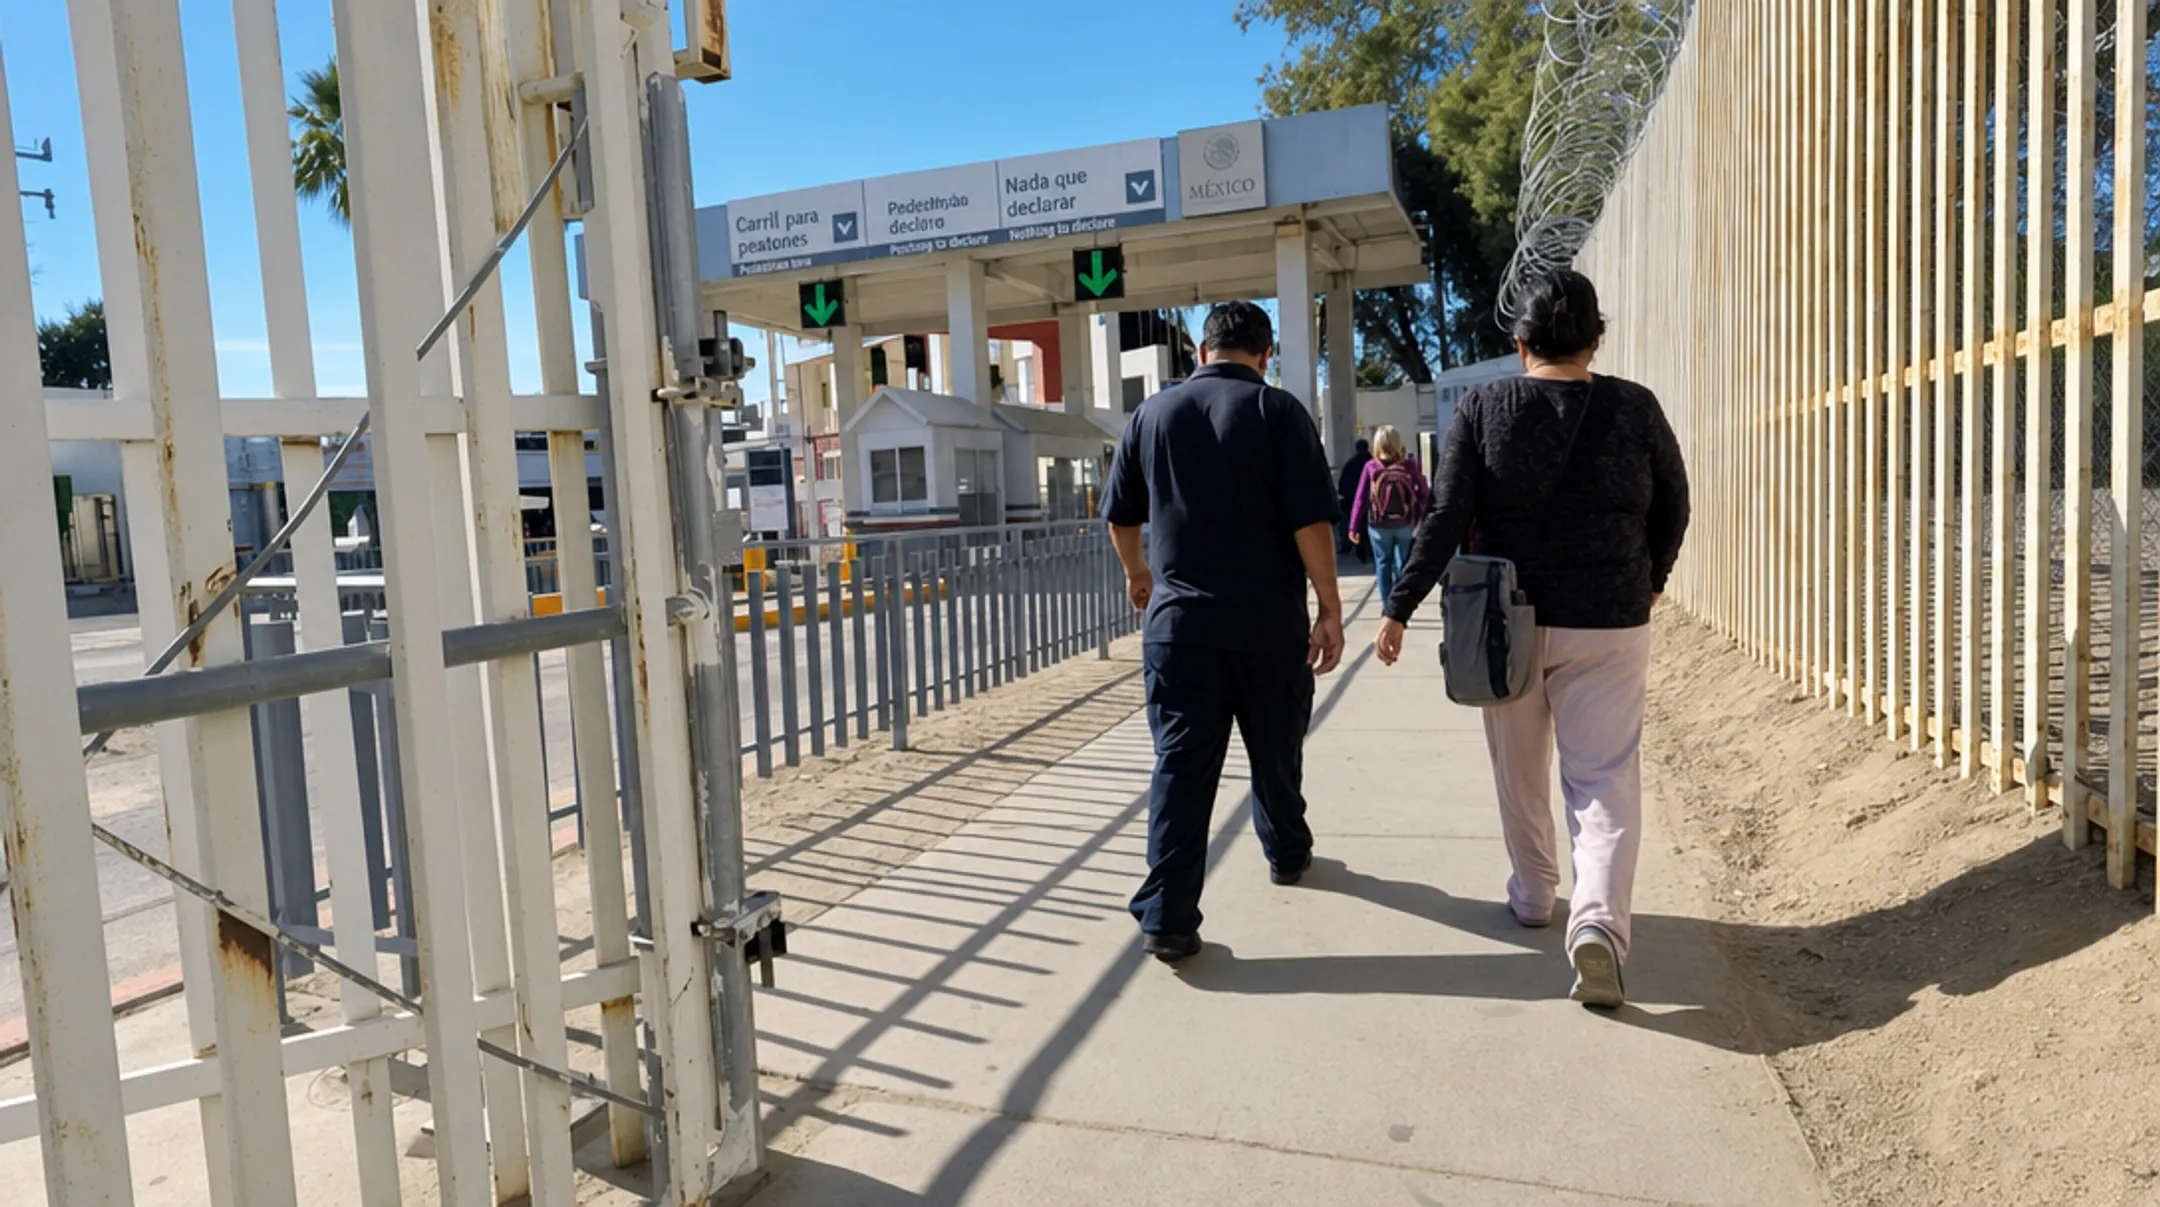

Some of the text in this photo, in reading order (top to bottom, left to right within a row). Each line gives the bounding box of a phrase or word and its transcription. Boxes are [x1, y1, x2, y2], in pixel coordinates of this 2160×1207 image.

[1006, 170, 1087, 194] Nada que
[1189, 177, 1255, 200] MÉXICO
[1007, 196, 1076, 217] declarar
[736, 209, 819, 233] Carril para
[738, 233, 809, 259] peatones
